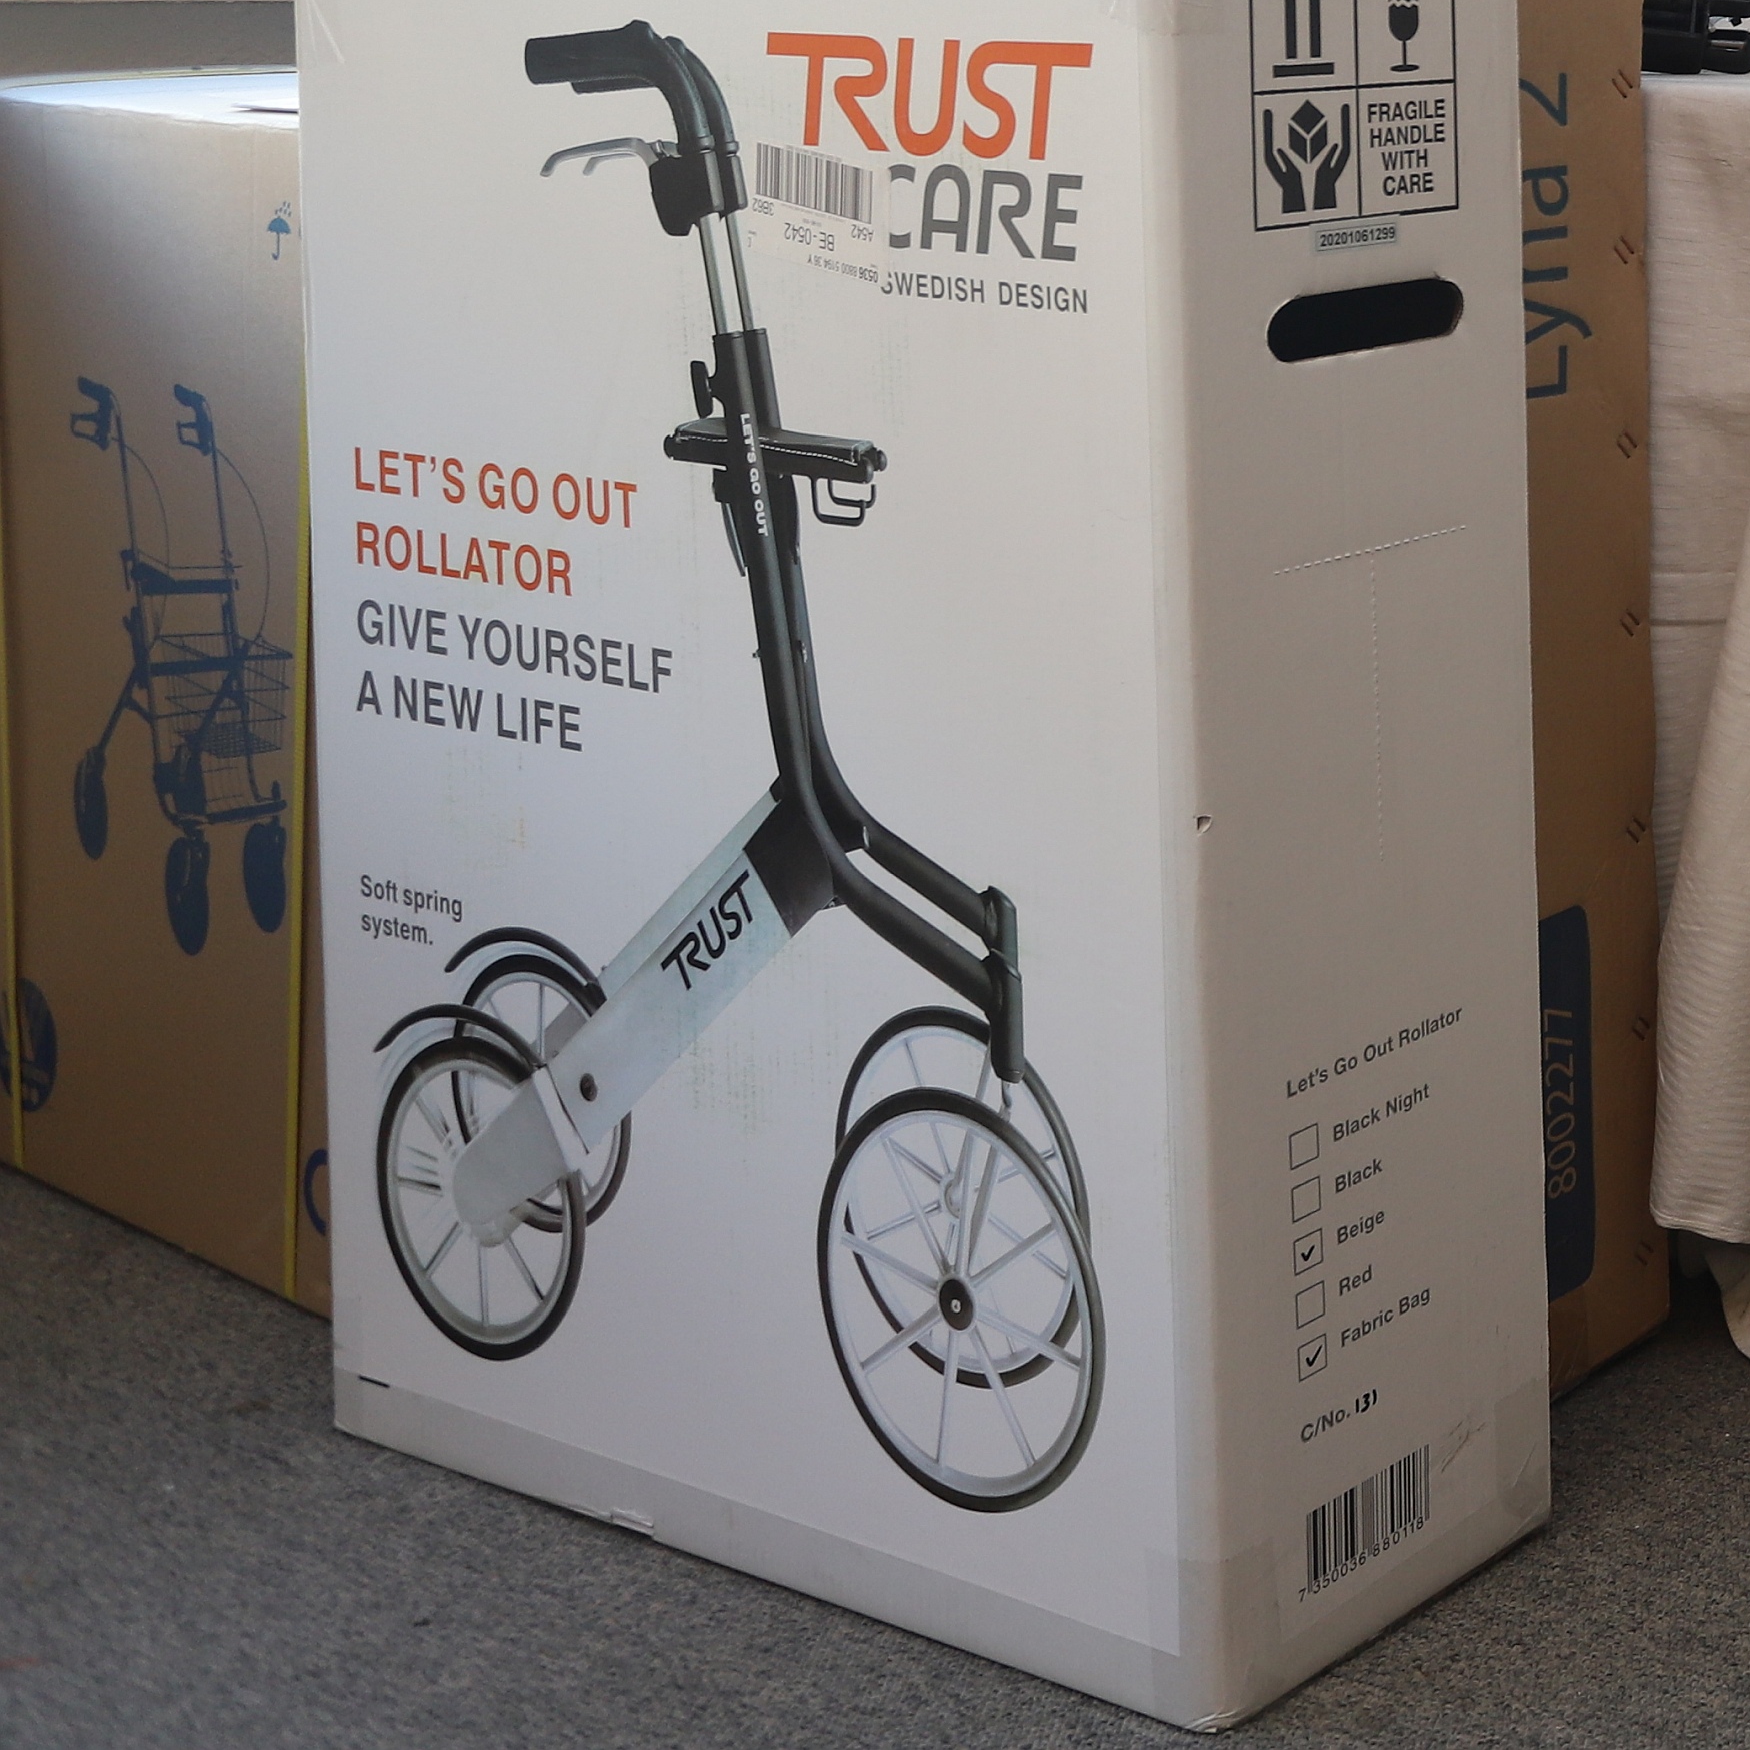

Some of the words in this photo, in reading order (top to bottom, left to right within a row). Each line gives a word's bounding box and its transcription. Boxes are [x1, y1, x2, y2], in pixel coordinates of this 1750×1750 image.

[765, 30, 1094, 161] TRUST
[1367, 98, 1446, 124] FRAGILE
[1369, 122, 1446, 148] HANDLE
[1381, 148, 1429, 172] WITH
[1382, 171, 1434, 197] CARE
[1319, 226, 1396, 248] 20201061299
[880, 270, 986, 304] SWEDISH
[998, 281, 1088, 314] DESIGN
[739, 411, 758, 468] LET'S
[353, 446, 466, 505] LET'S
[478, 462, 540, 515] GO
[552, 472, 638, 529] OUT
[748, 470, 762, 496] GO
[752, 498, 769, 538] OUT
[356, 521, 573, 597] ROLLATOR
[356, 599, 448, 657] GIVE
[458, 614, 673, 694] YOURSELF
[355, 670, 382, 717] A
[393, 675, 484, 733] NEW
[496, 693, 583, 752] LIFE
[360, 874, 399, 906] Soft
[402, 885, 463, 923] spring
[361, 914, 434, 947] system.
[659, 869, 758, 991] TRUST
[1285, 1065, 1329, 1100] Let's
[1333, 1054, 1359, 1080] Go
[1362, 1040, 1394, 1067] Out
[1398, 1005, 1463, 1050] Rollator
[1332, 1107, 1381, 1144] Black
[1384, 1083, 1431, 1123] Night
[1545, 1006, 1576, 1200] 8002277
[1334, 1158, 1384, 1196] Black
[1336, 1207, 1386, 1246] Beige
[1338, 1264, 1374, 1298] Red
[1339, 1305, 1395, 1349] Fabric
[1398, 1285, 1432, 1318] Bag
[1300, 1407, 1352, 1444] C/No.
